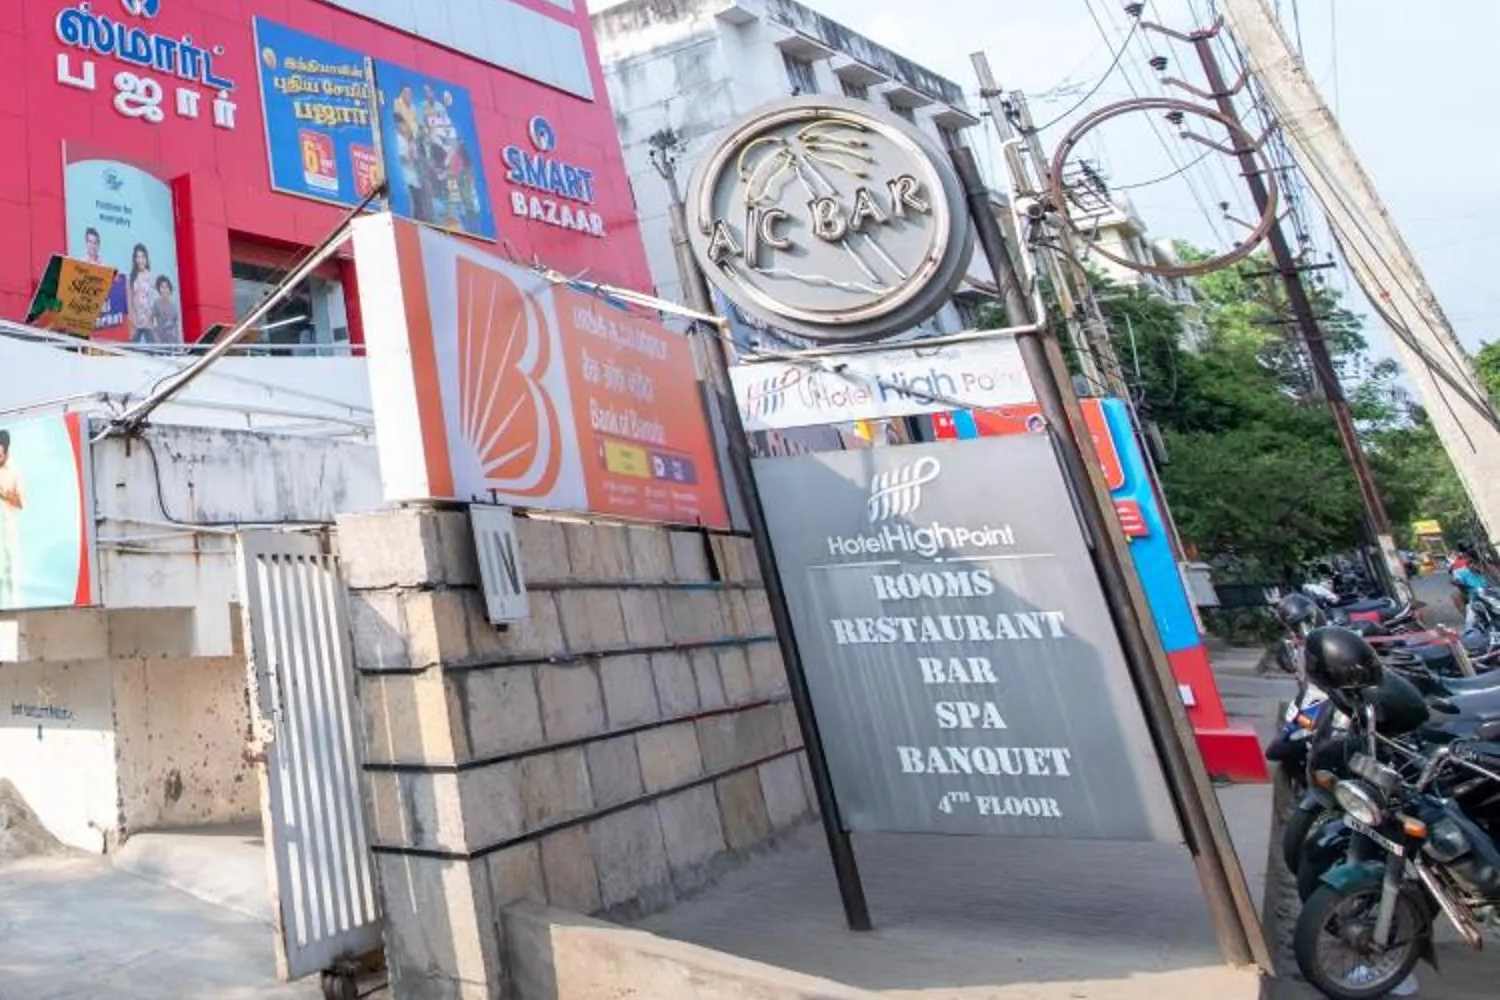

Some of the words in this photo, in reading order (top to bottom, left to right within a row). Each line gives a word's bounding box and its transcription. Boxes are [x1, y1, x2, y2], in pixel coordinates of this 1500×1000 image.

[56, 1, 236, 92] ஸ்மார்ட்
[502, 145, 594, 204] SMART
[511, 191, 606, 237] BAZAAR
[806, 174, 933, 242] BAR
[876, 368, 958, 406] High
[872, 569, 995, 601] ROOMS
[830, 611, 1066, 645] RESTAURANT
[918, 657, 998, 684] BAR
[935, 701, 1008, 729] SPA
[897, 746, 1072, 777] BANQUET
[974, 795, 1063, 818] FLOOR
